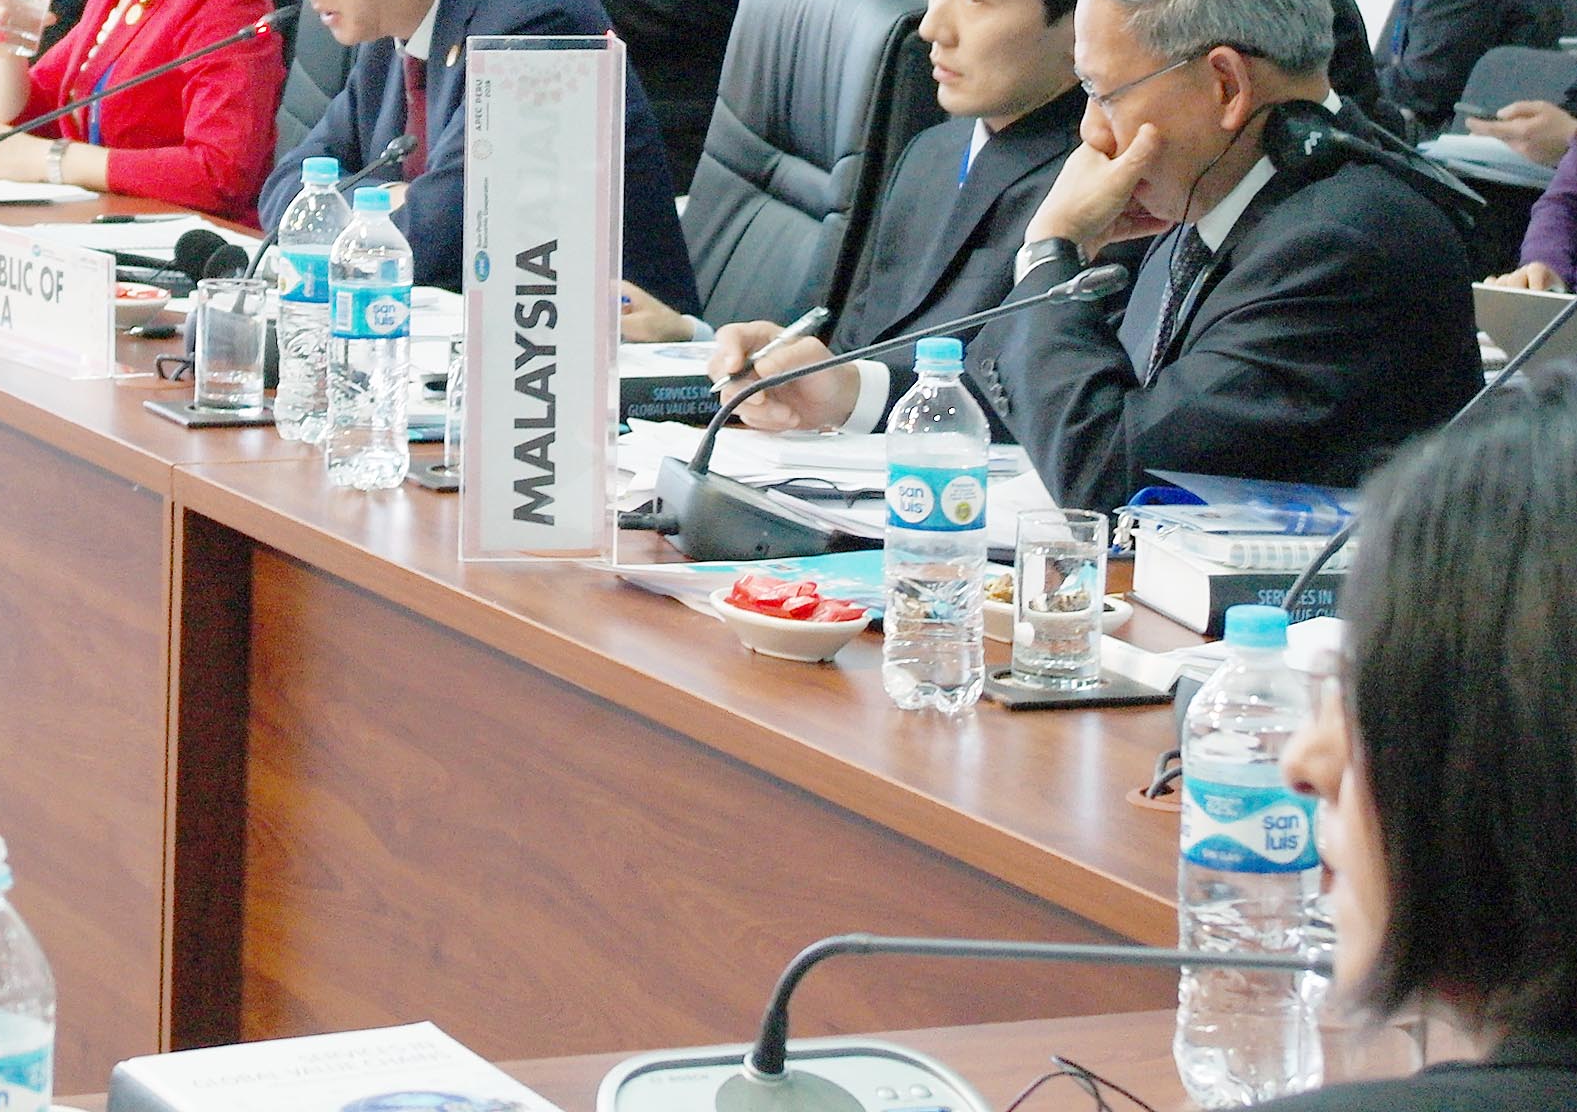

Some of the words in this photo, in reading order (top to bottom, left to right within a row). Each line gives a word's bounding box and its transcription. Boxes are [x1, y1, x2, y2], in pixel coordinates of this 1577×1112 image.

[40, 266, 64, 304] OF
[372, 303, 396, 314] san
[513, 238, 559, 526] MALAYSIA
[653, 386, 699, 401] SERVICES
[665, 401, 696, 415] VALUE
[1318, 589, 1333, 605] IN
[1263, 814, 1299, 830] san
[1265, 830, 1299, 851] luis
